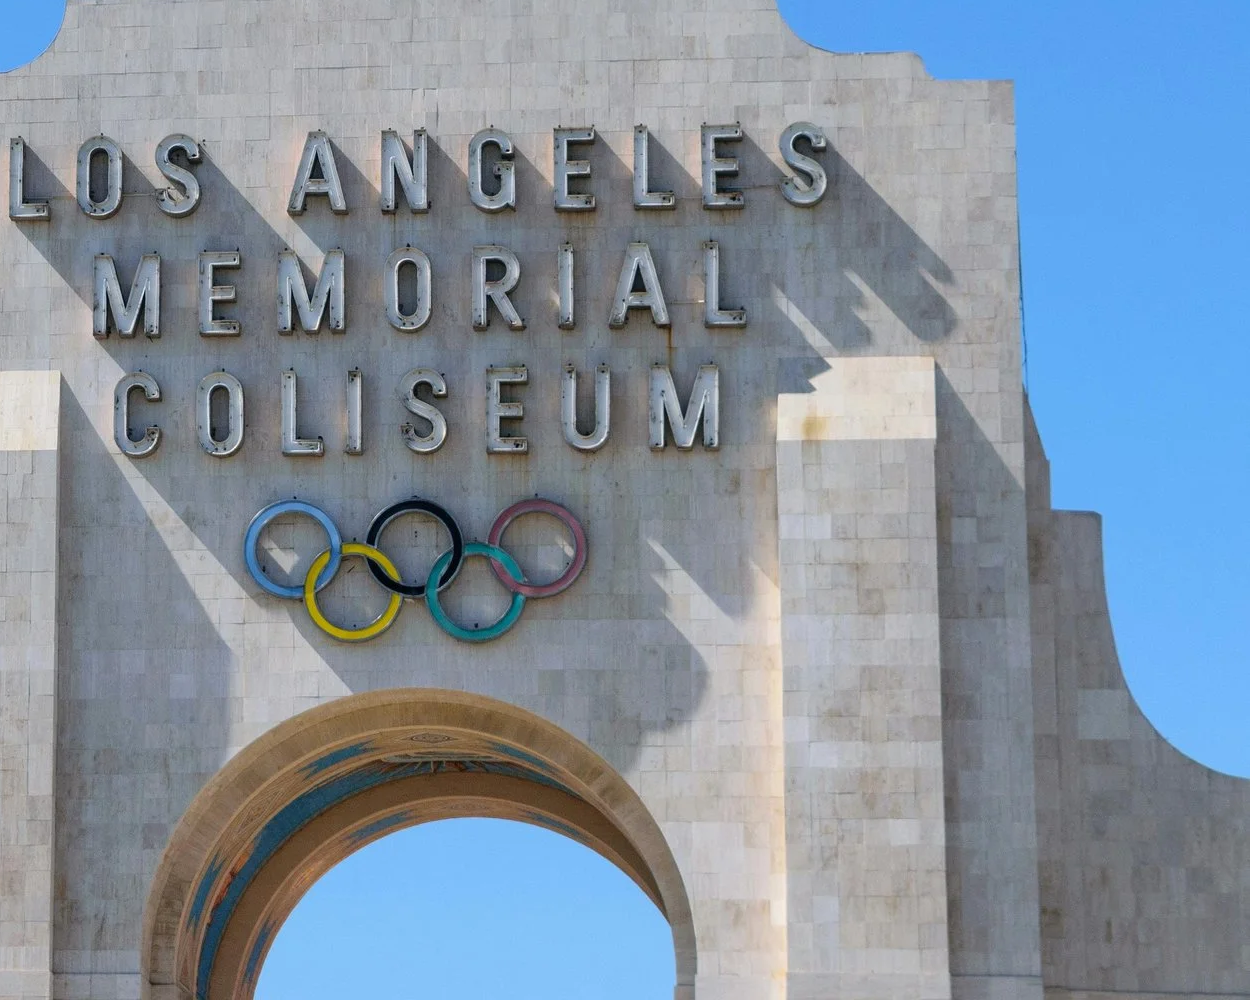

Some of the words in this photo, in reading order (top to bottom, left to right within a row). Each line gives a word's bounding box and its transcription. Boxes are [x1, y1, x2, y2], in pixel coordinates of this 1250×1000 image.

[9, 133, 202, 221] LOS
[287, 121, 828, 215] ANGELES
[93, 242, 747, 338] MEMORIAL
[113, 365, 721, 458] COLISEUM
